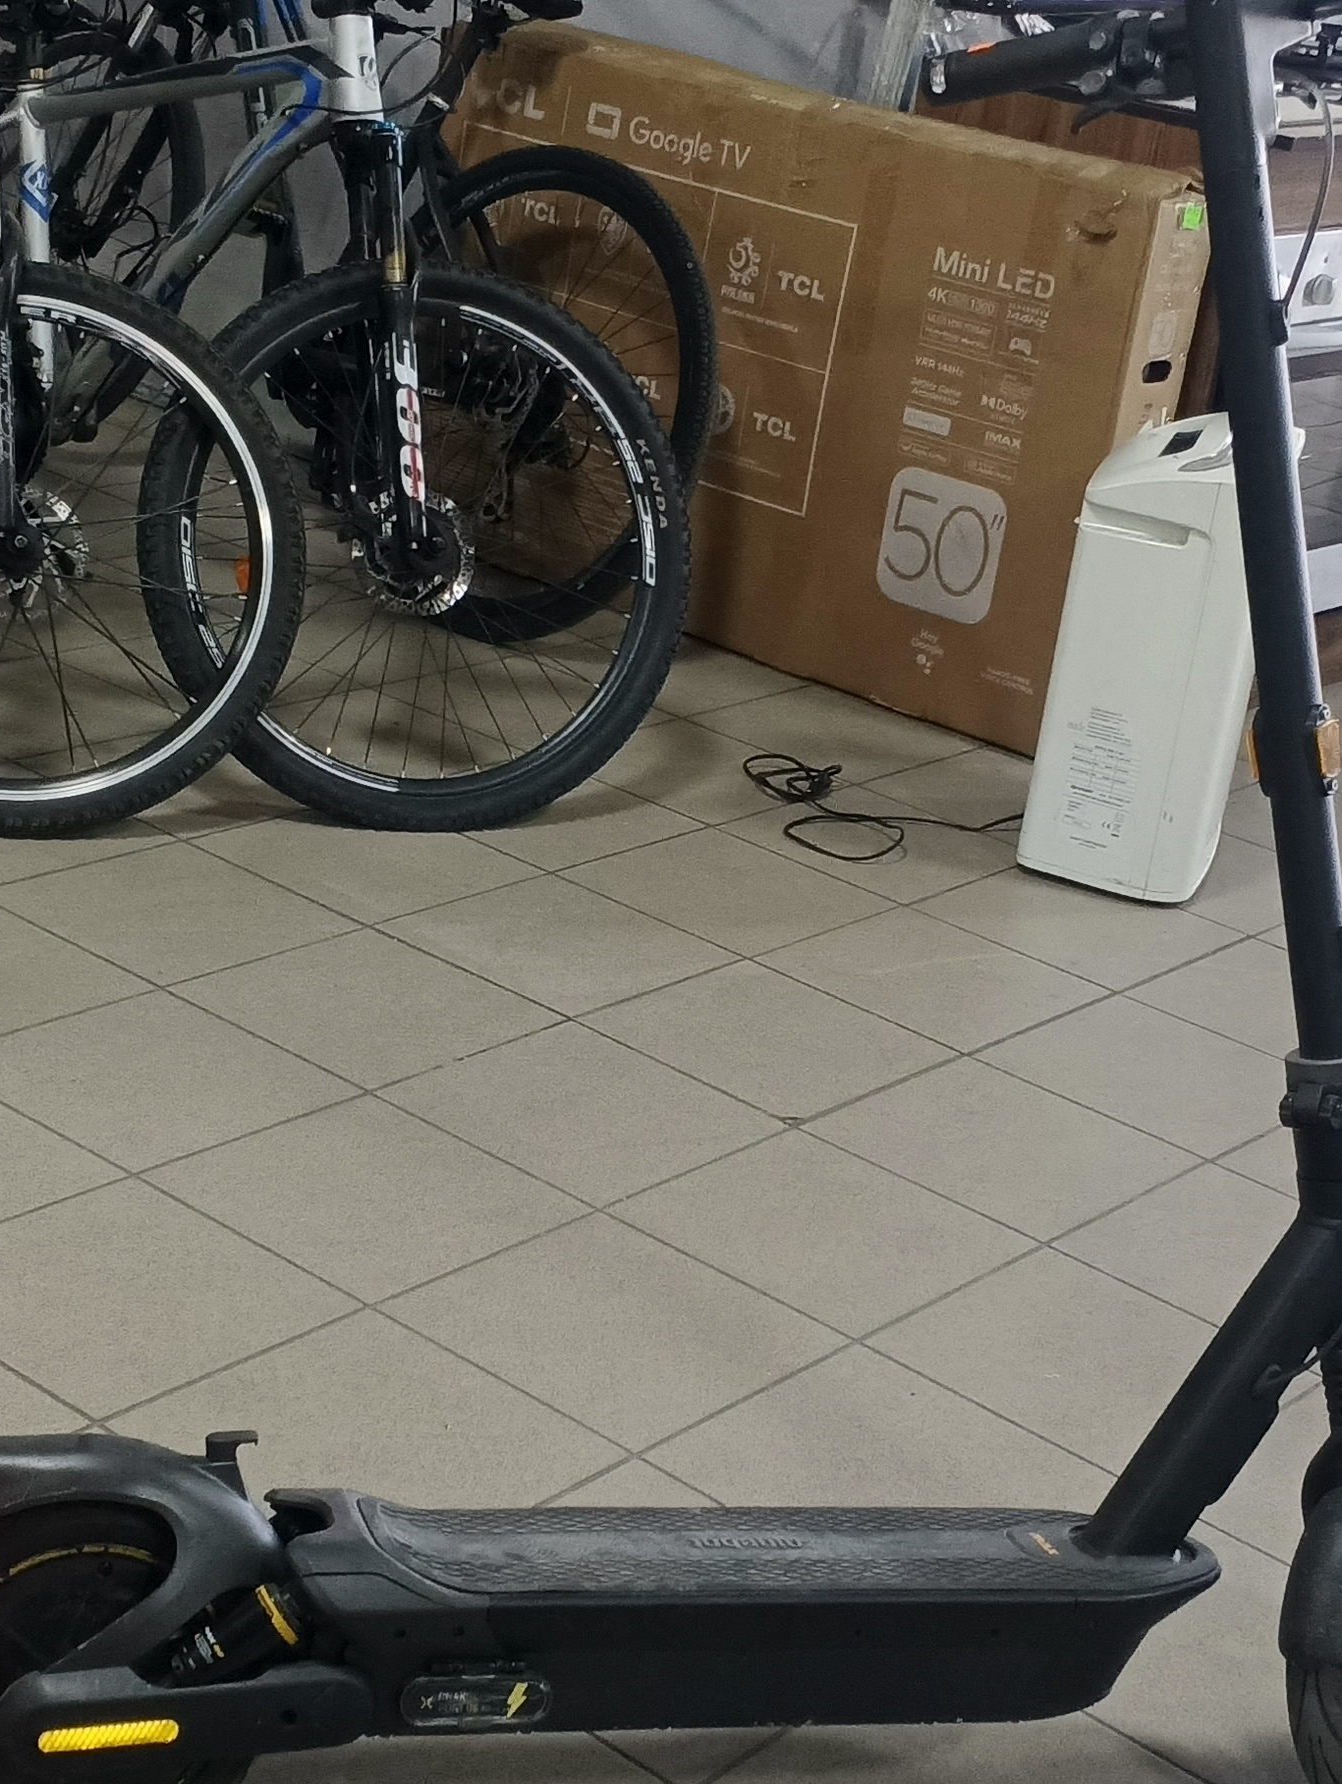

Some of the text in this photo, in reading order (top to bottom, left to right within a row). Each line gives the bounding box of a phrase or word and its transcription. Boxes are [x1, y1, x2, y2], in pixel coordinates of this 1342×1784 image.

[472, 78, 546, 121] CL
[629, 115, 752, 170] Google TV
[778, 269, 825, 302] TCL
[933, 246, 991, 284] Mini
[996, 262, 1055, 299] LED
[927, 286, 950, 304] 4K
[632, 374, 661, 400] CL
[753, 411, 797, 442] TCL
[996, 397, 1028, 420] Dolby
[984, 430, 1022, 450] IMAX
[636, 437, 669, 529] KENDA
[884, 487, 1005, 597] 50"
[180, 515, 204, 614] DISC
